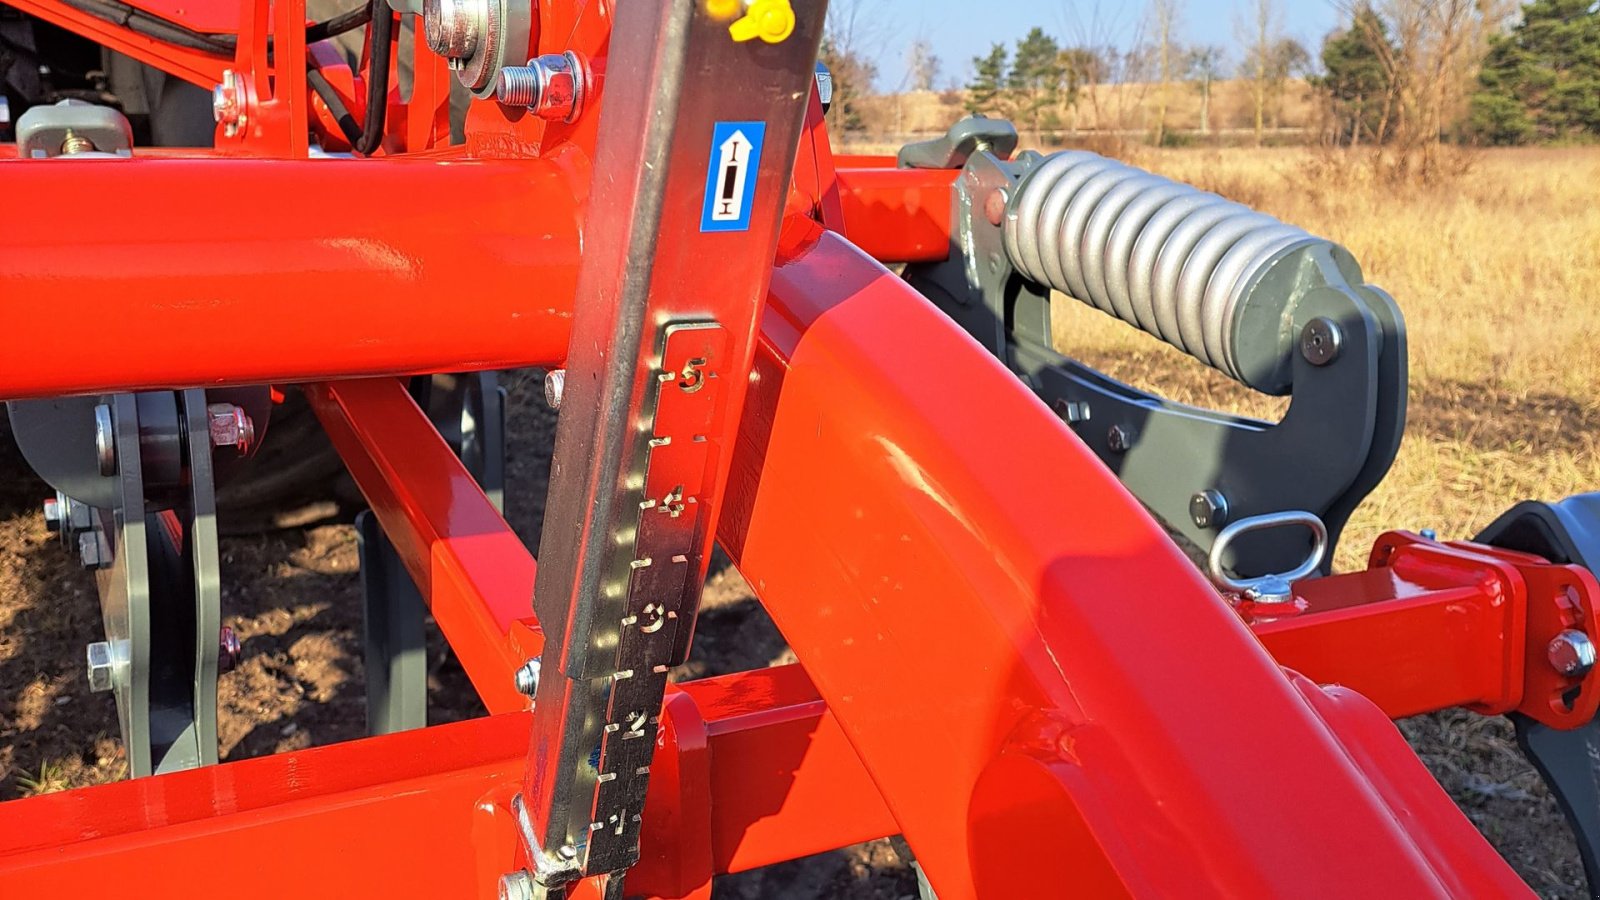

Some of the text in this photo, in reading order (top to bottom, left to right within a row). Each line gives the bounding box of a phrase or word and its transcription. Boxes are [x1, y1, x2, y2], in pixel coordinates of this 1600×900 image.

[678, 357, 707, 393] 5
[657, 485, 685, 518] 4
[640, 602, 665, 634] 3
[622, 709, 648, 740] 2
[609, 808, 627, 836] 1
